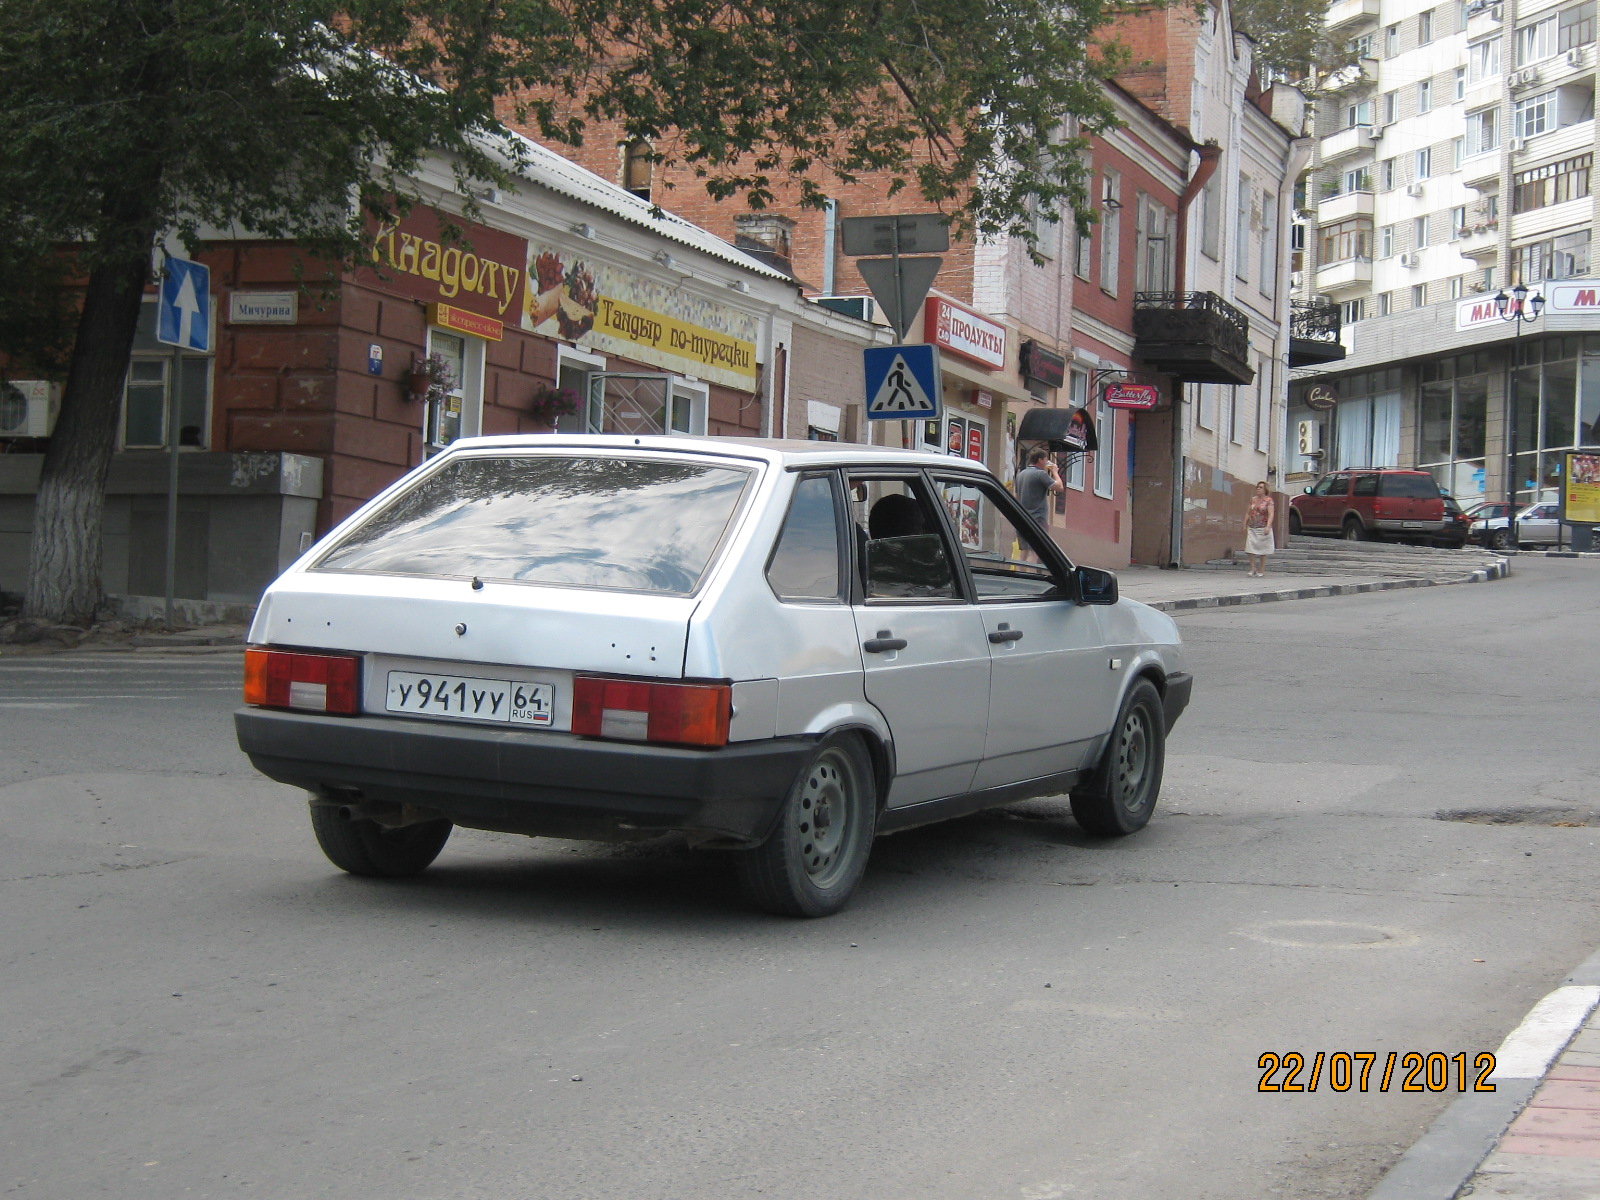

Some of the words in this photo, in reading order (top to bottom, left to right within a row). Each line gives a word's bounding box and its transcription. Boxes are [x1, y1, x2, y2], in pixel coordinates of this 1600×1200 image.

[372, 213, 519, 315] Анадолу
[239, 304, 290, 318] Мичурина
[941, 304, 951, 320] 24
[603, 299, 661, 347] Тандыр
[670, 327, 749, 368] по-турецки
[952, 317, 1003, 355] ПРОДУКТЫ
[1110, 389, 1152, 402] Butterfly
[513, 686, 542, 710] 64
[512, 709, 533, 719] RUS
